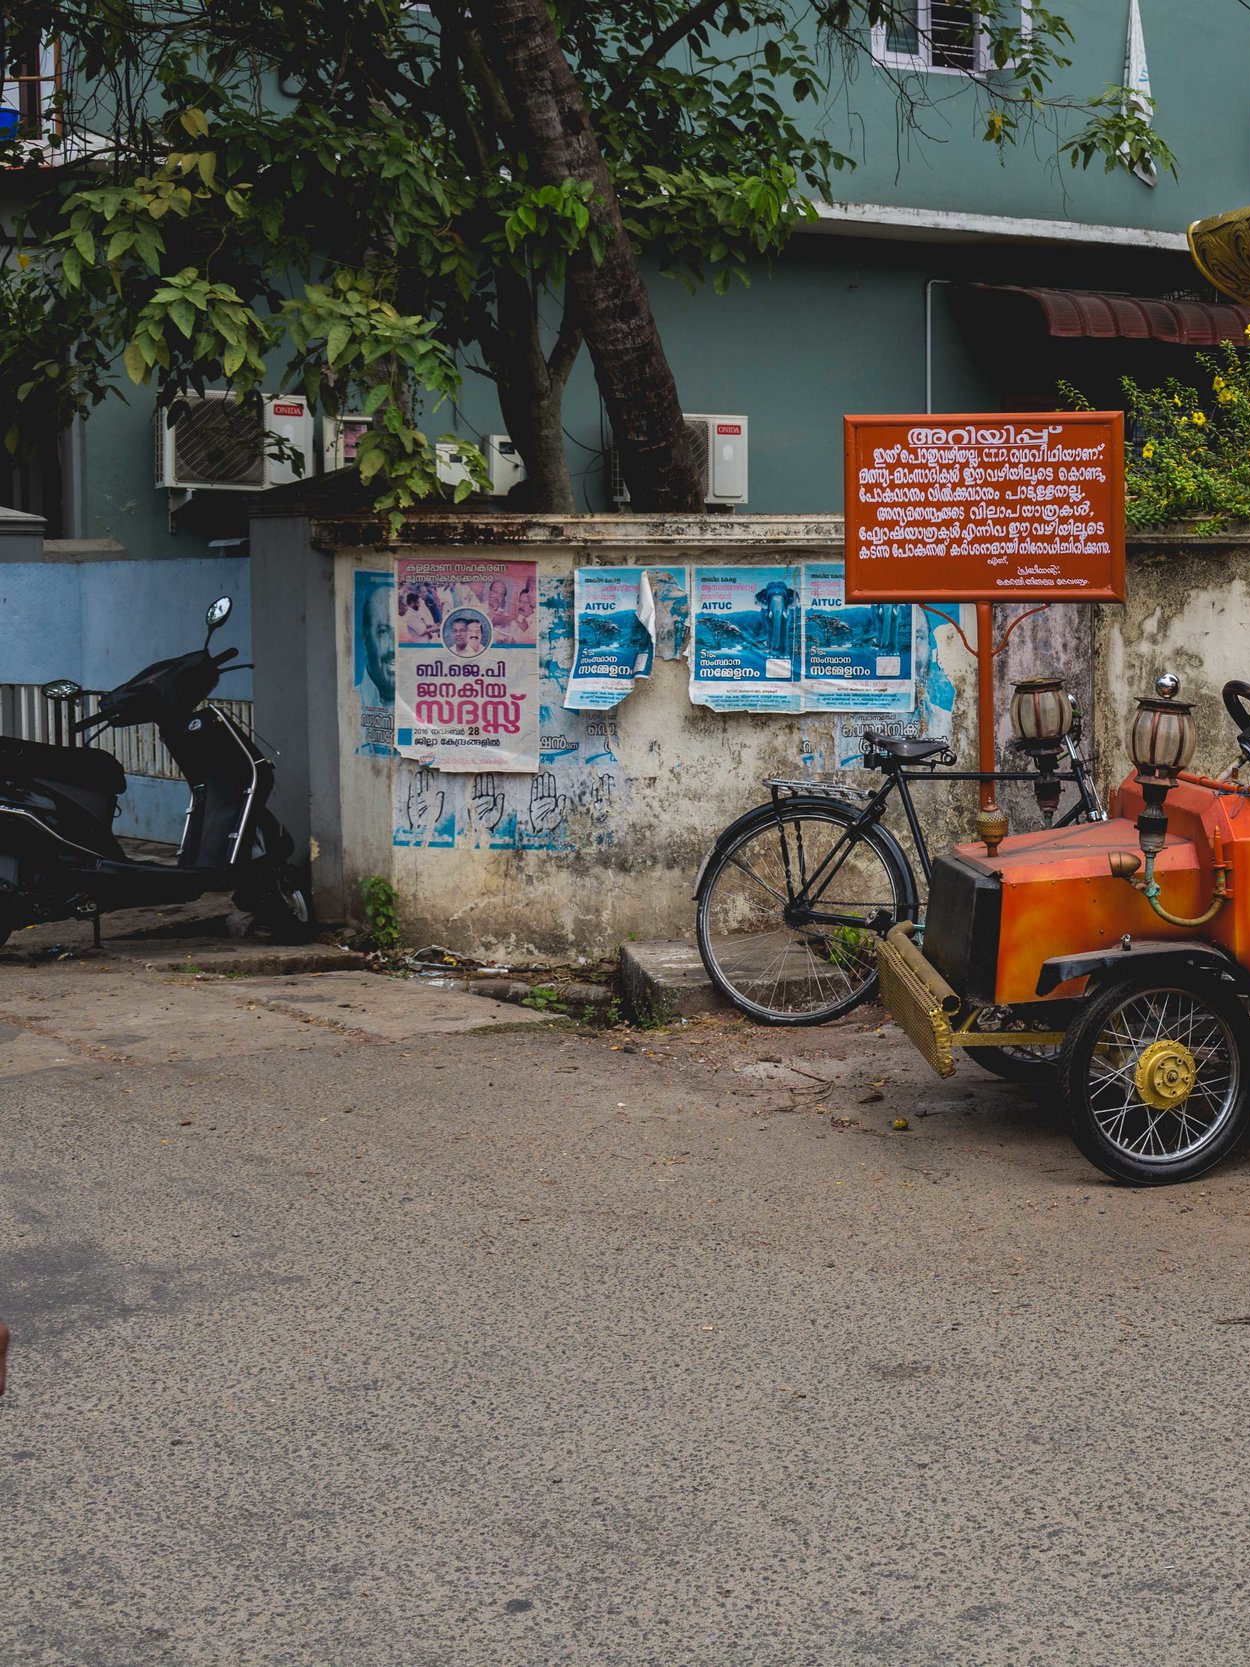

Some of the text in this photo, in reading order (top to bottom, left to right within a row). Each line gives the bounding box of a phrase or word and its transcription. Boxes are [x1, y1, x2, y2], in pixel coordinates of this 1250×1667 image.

[275, 406, 302, 415] ONIDA
[718, 426, 740, 434] ONIDA
[908, 424, 1063, 445] അറിയിപ്പ്
[873, 443, 901, 467] ഇത്
[982, 448, 1008, 462] C.T.D.
[963, 467, 985, 485] ഈ
[986, 463, 1053, 485] വഴിയിലൂടെ
[961, 519, 1006, 541] എന്നിവ
[1008, 521, 1030, 538] ഈ
[1032, 518, 1105, 540] വഴിയിലൂടെ
[454, 563, 507, 572] സഹകരണ
[584, 602, 616, 610] AITUC
[701, 601, 732, 610] AITUC
[811, 598, 842, 607] AITUC
[580, 656, 618, 664] സംസ്ഥാന
[810, 656, 852, 664] സംസ്ഥാന
[415, 660, 506, 677] ബി.ജെ.പി
[699, 667, 760, 680] സമ്മേളനം
[810, 665, 871, 678] സമ്മേളനം
[416, 679, 507, 698] ജനകീയ
[415, 693, 527, 735] സദസ്സ്
[467, 726, 480, 736] 28
